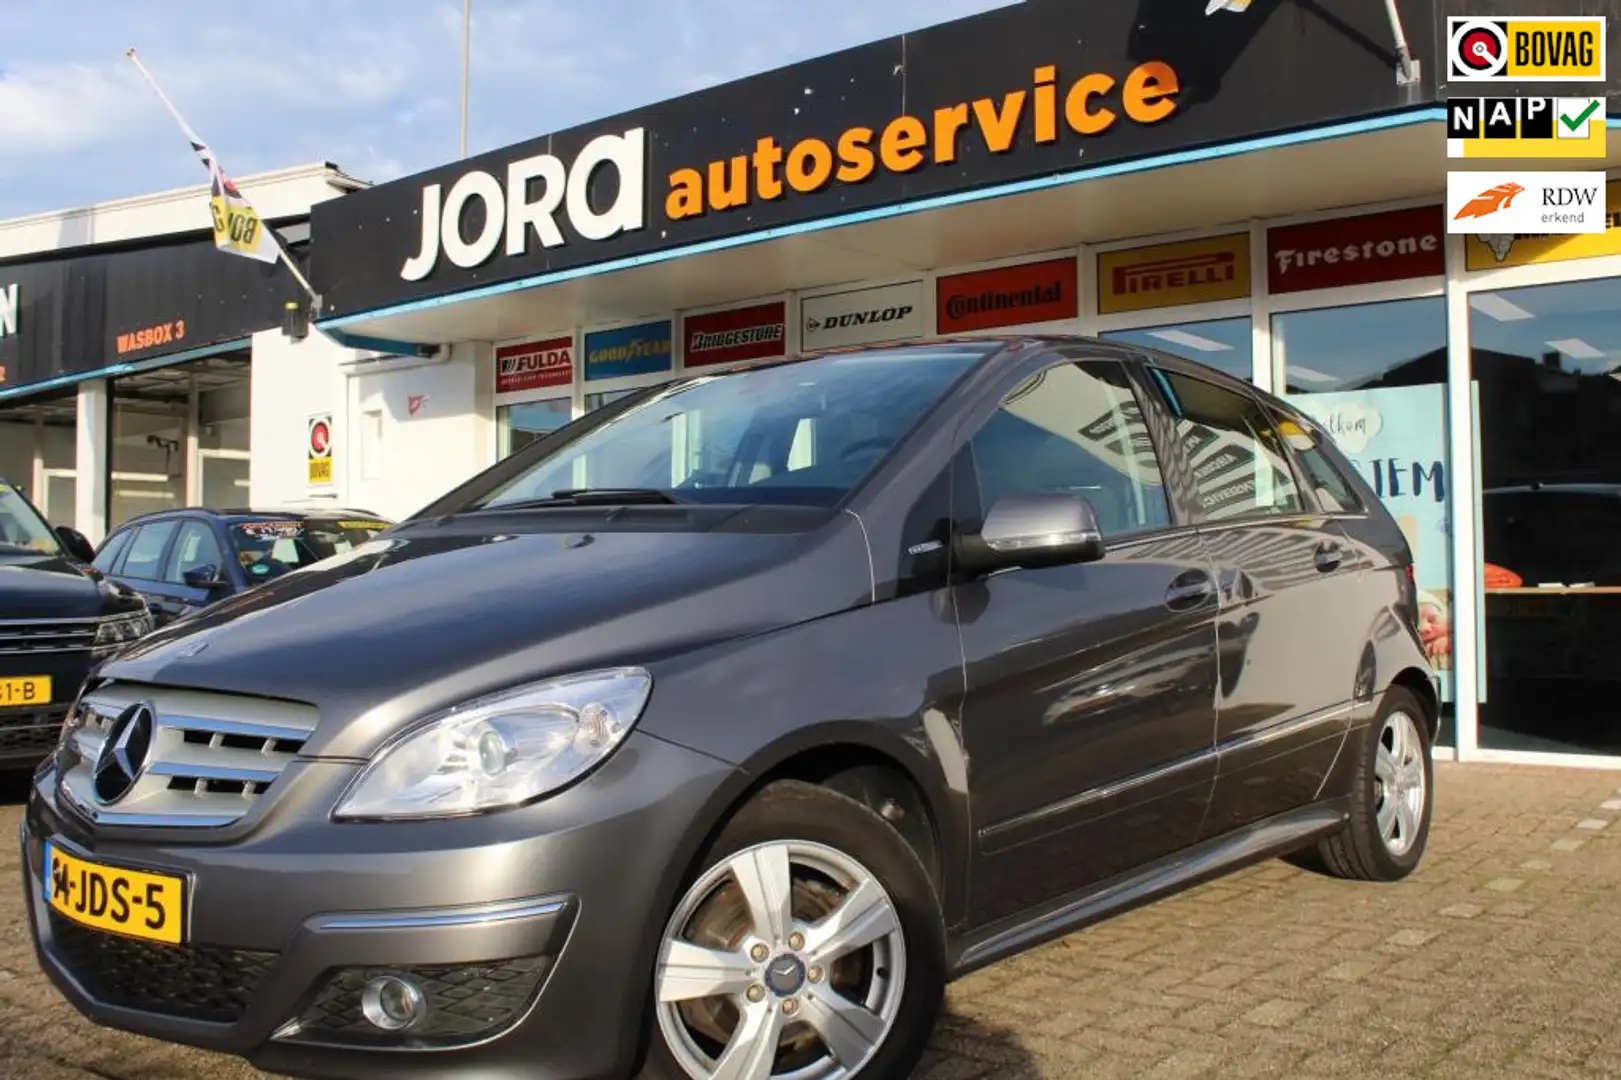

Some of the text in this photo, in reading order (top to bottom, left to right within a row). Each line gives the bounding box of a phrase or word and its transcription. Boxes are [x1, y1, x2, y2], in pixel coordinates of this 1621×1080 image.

[664, 60, 1180, 220] autoservice
[1274, 233, 1438, 275] Firestone
[1112, 252, 1236, 295] PIRELLI
[945, 281, 1063, 319] Continental
[822, 305, 913, 331] DUNLOP
[117, 319, 185, 353] WASBOX 3
[690, 323, 784, 352] BRIDGESTONE
[516, 350, 571, 372] FULDA
[0, 681, 36, 701] 1-B
